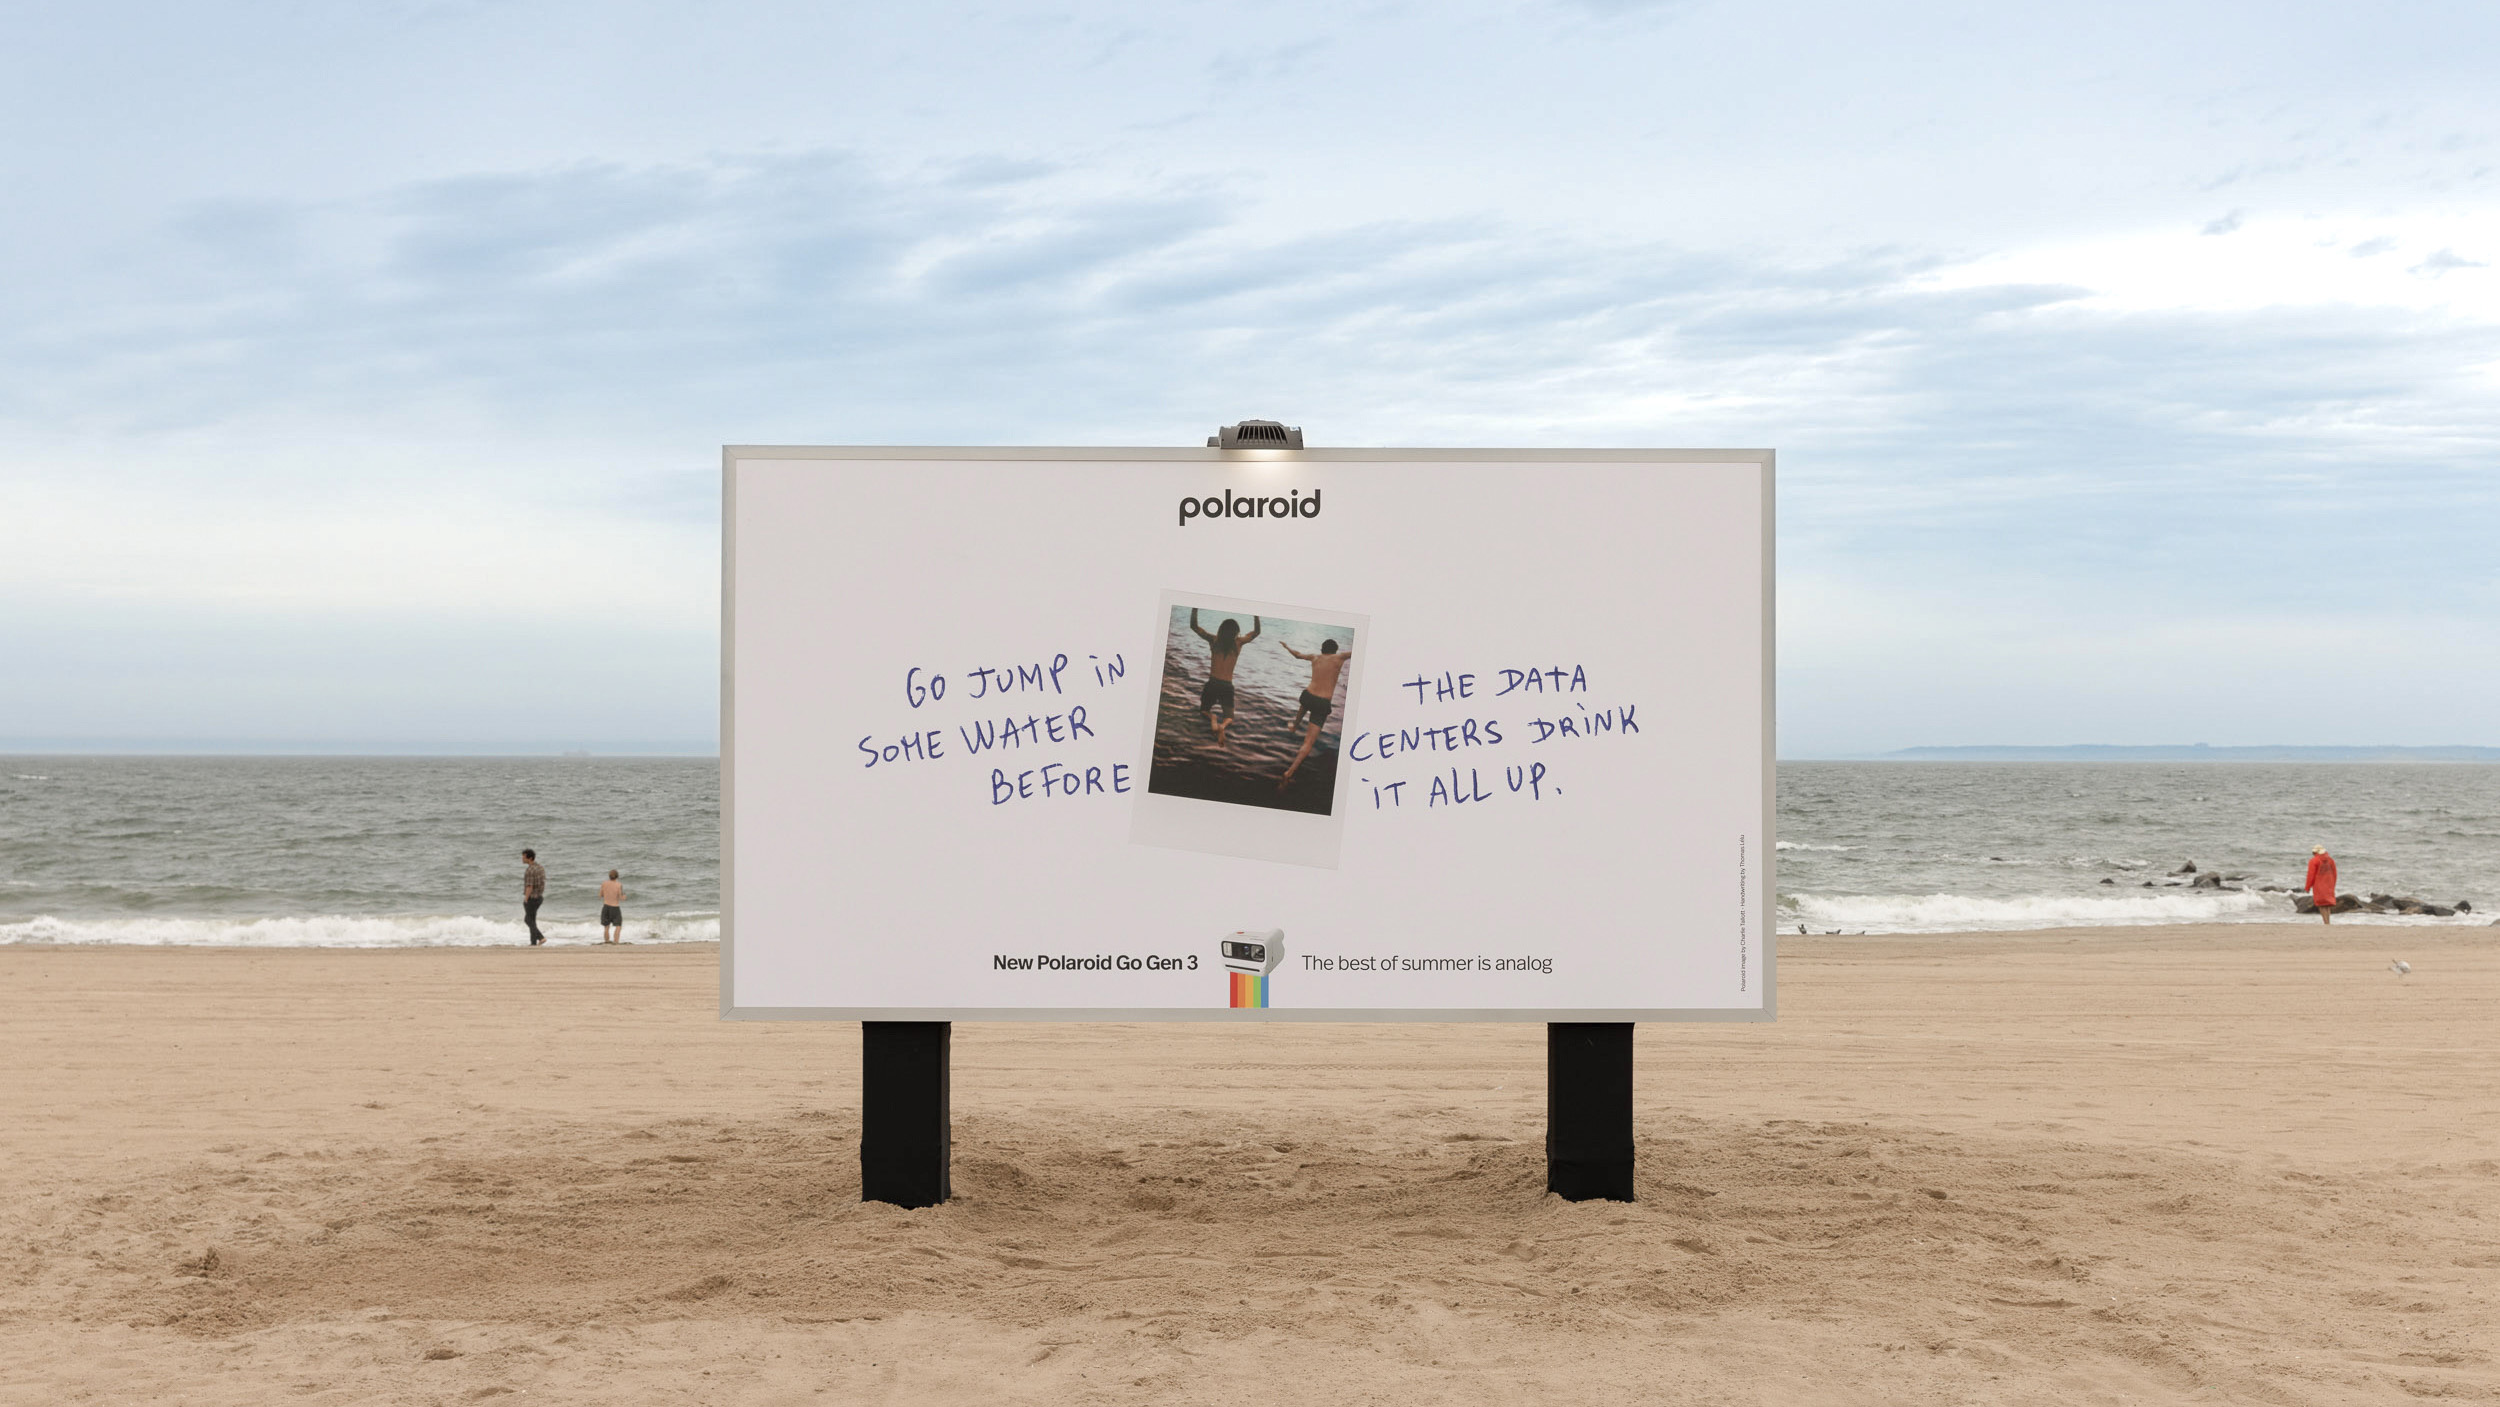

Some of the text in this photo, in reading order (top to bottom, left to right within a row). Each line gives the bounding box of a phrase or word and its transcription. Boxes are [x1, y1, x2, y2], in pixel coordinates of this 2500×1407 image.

[1178, 488, 1322, 527] polaroid
[906, 666, 946, 709] GO
[966, 653, 1070, 699] JUMP
[1401, 663, 1587, 706] THE DATA
[858, 705, 1095, 769] SOME WATER
[1349, 718, 1503, 762] CENTERS
[991, 762, 1132, 806] BEFORE
[1429, 766, 1493, 809] ALL
[1506, 761, 1562, 801] UP.
[993, 953, 1199, 971] New Polaroid Go Gen 3
[1301, 954, 1553, 975] The best of summer is analog
